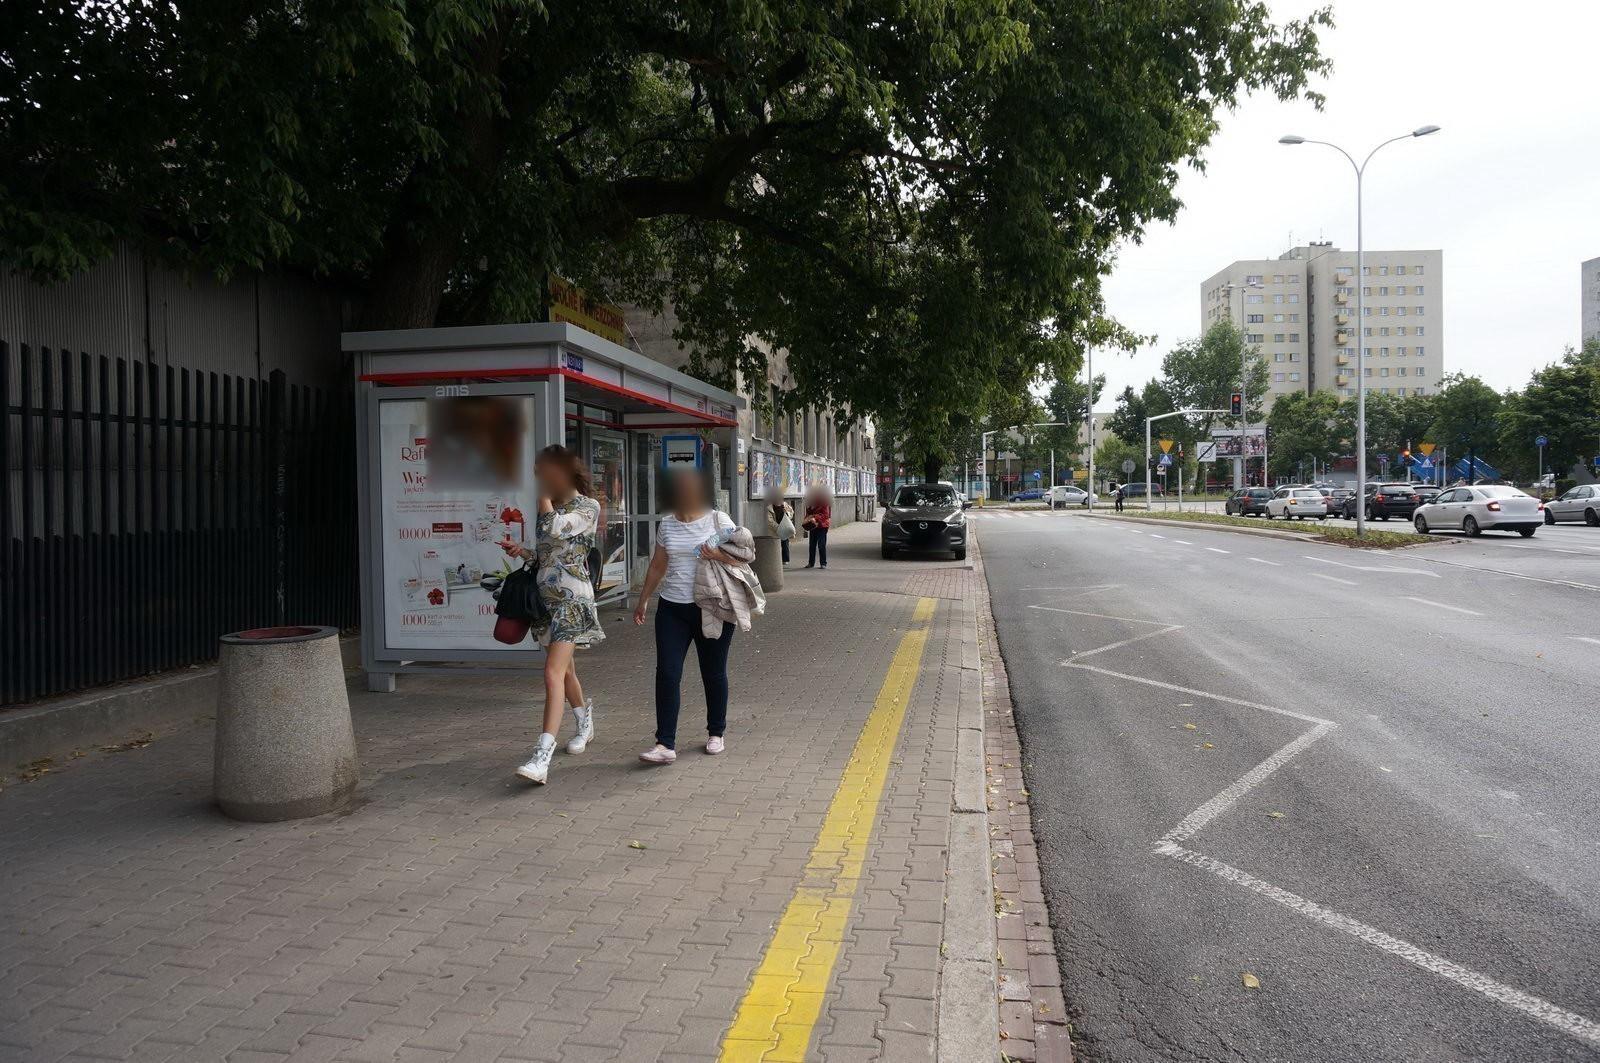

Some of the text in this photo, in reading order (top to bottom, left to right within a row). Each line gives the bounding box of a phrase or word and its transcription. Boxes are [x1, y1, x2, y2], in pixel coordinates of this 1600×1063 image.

[435, 384, 470, 397] ams
[402, 471, 427, 487] Wię
[478, 604, 496, 616] 100
